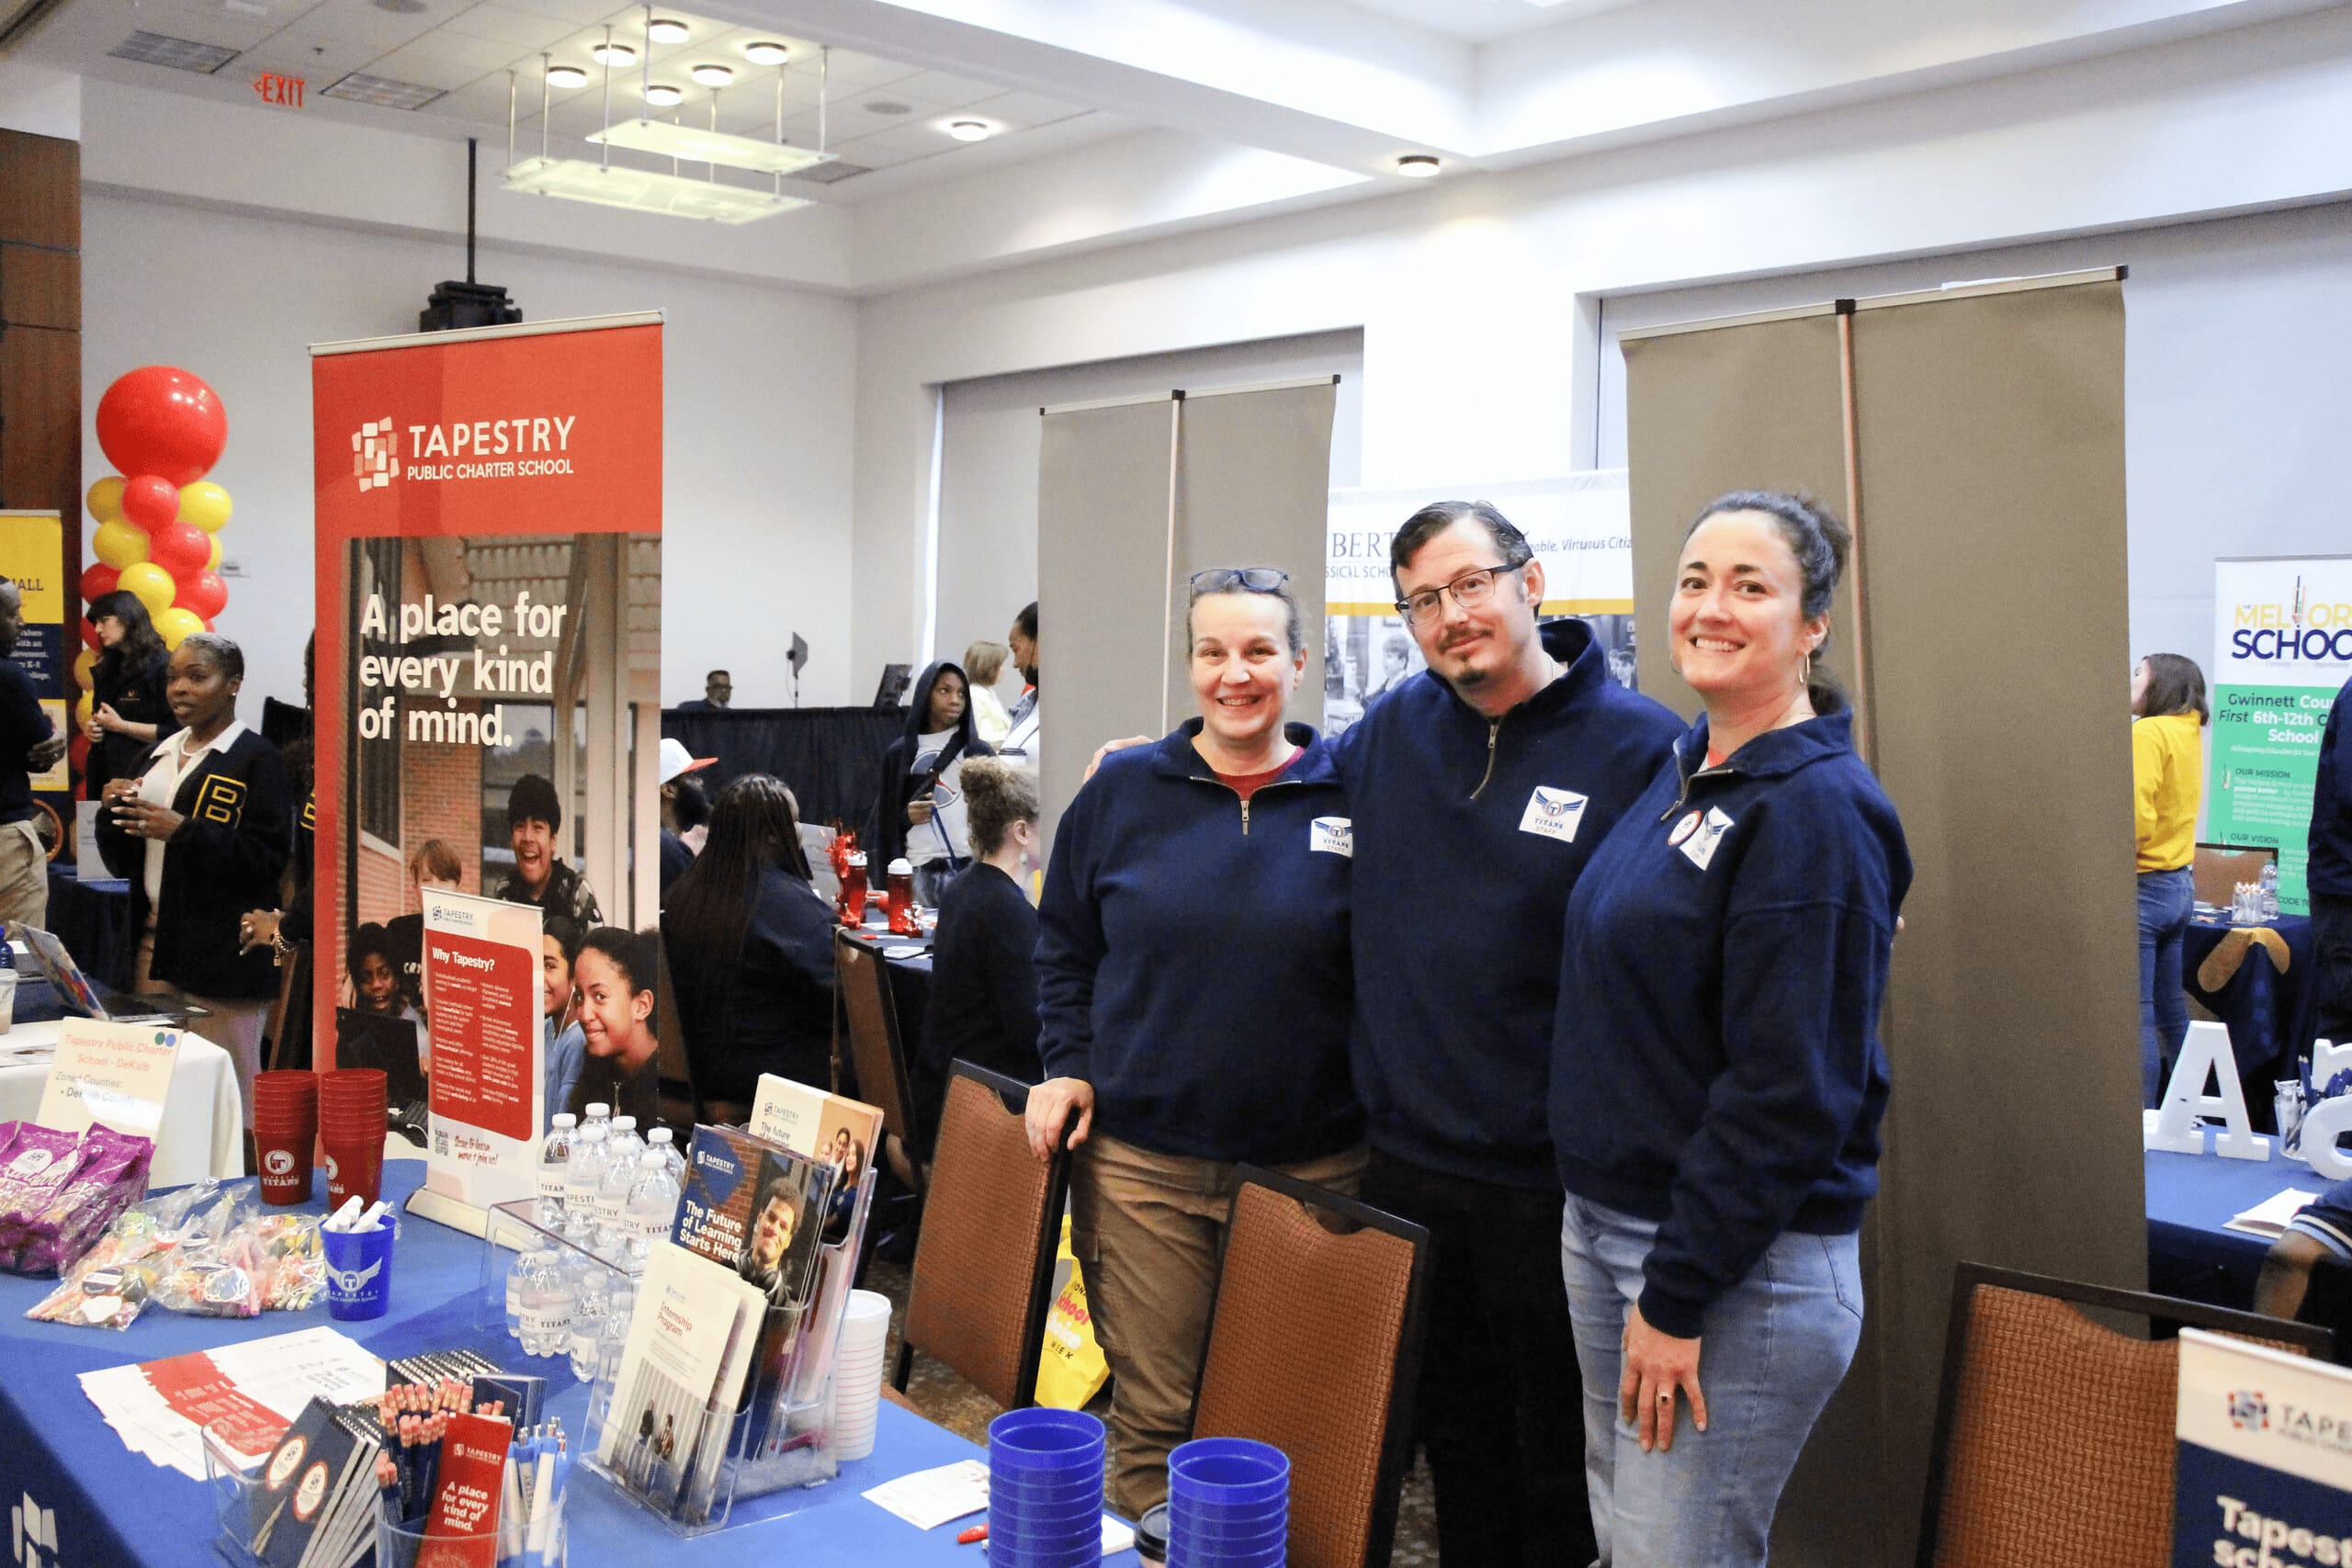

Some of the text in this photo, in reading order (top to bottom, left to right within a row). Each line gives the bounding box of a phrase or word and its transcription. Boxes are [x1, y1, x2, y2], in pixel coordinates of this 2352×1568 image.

[262, 73, 305, 108] EXIT
[409, 415, 576, 458] TAPESTRY
[407, 458, 573, 481] PUBLIC CHARTER SCHOOL
[1332, 532, 1396, 558] BERT
[1562, 538, 1606, 551] Virtuous
[1608, 536, 1632, 549] Citiz
[1325, 566, 1392, 578] SSICAL SCHO
[360, 591, 568, 644] A place for
[2232, 628, 2352, 660] SCHOO
[359, 644, 553, 698] every kind
[2228, 693, 2295, 708] Gwinnett
[359, 696, 513, 748] of mind.
[2219, 709, 2249, 723] First
[2252, 710, 2314, 727] 6th-12th
[2267, 728, 2321, 744] School
[2235, 768, 2291, 779] OUR MISSION
[2230, 832, 2279, 845] OUR VISION
[432, 947, 495, 972] Why Tapestry?
[65, 1034, 174, 1056] Tapestry Public Charter
[77, 1053, 108, 1067] School
[117, 1058, 151, 1072] DeKalb
[55, 1071, 123, 1089] Zoned Counties:
[774, 1105, 799, 1120] TAPESTRY
[761, 1122, 791, 1139] The future
[706, 1154, 735, 1171] TAPESTRY
[263, 1177, 300, 1187] TITANS
[540, 1183, 564, 1192] TITAN
[686, 1200, 742, 1233] The Future
[682, 1214, 742, 1250] of Learning
[680, 1229, 740, 1263] Starts Here
[540, 1318, 571, 1328] TITANS
[657, 1311, 683, 1337] Program
[661, 1301, 693, 1332] Internship
[467, 1447, 502, 1461] TAPESTRY
[447, 1481, 488, 1500] A place
[441, 1490, 489, 1514] for every
[443, 1503, 481, 1521] kind of
[444, 1517, 473, 1532] mind.
